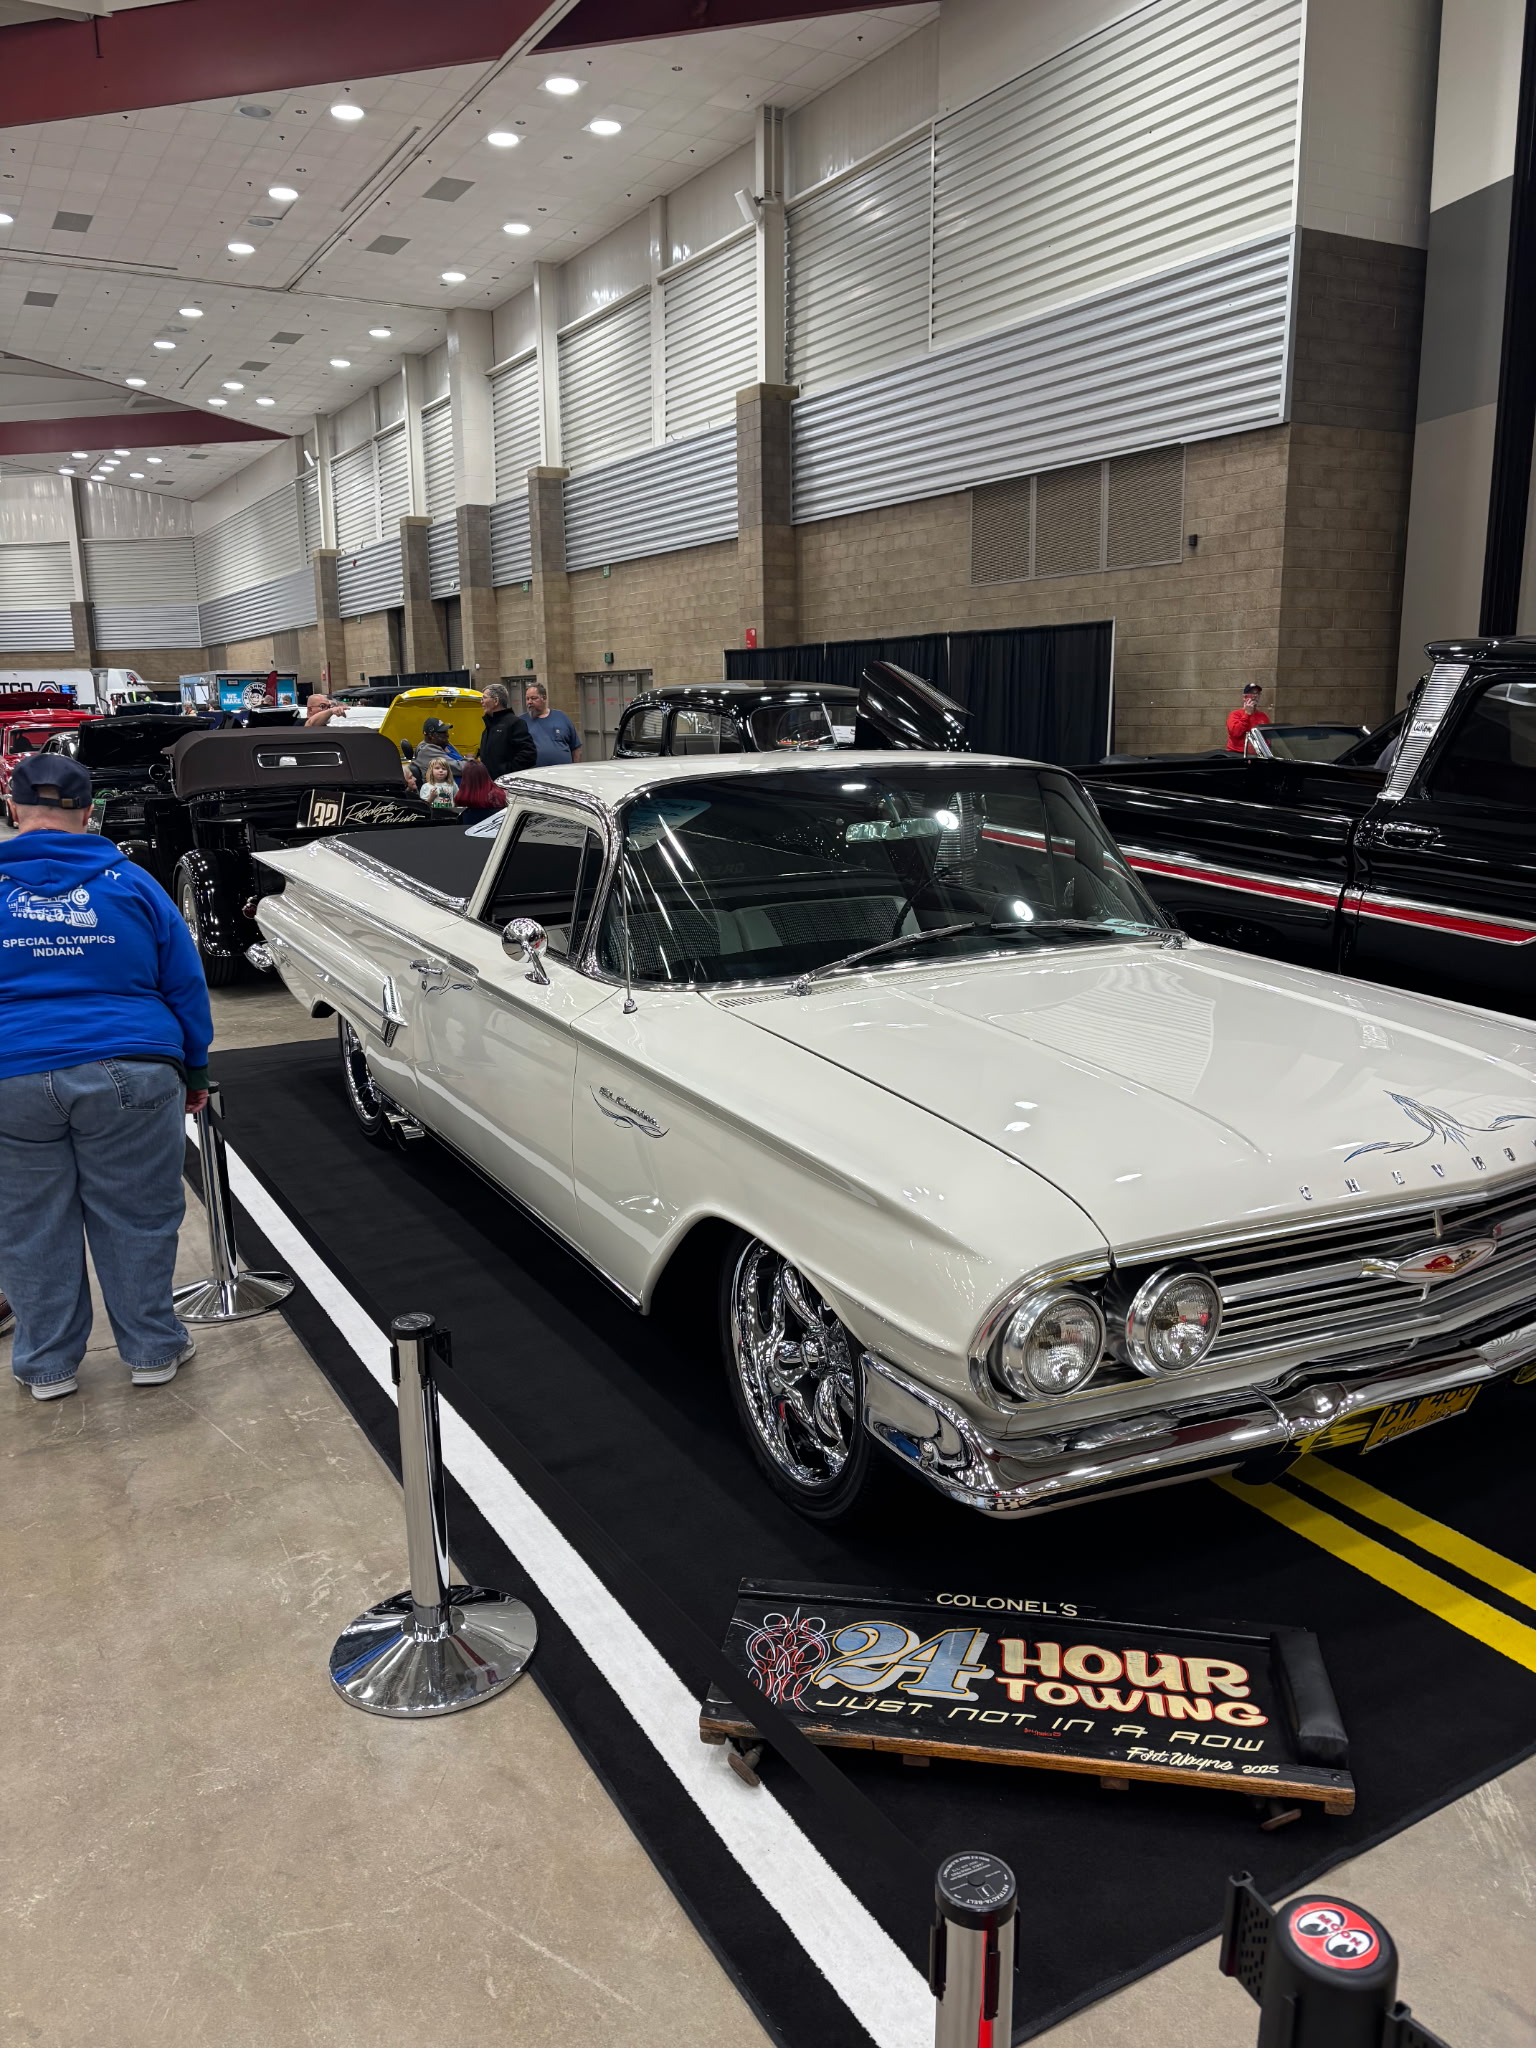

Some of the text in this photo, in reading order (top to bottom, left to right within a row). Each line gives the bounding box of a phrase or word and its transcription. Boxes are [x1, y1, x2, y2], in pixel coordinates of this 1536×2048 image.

[0, 682, 33, 693] TCO
[2, 935, 116, 948] SPECIAL OLYMPICS
[32, 946, 85, 958] INDIANA
[1299, 1138, 1536, 1201] CHEVRO
[1387, 1419, 1416, 1437] OHIO
[936, 1593, 1078, 1617] COLONEL'S
[811, 1620, 1251, 1701] 24 HOUR
[995, 1677, 1269, 1727] TOWING
[815, 1696, 933, 1716] JUST
[947, 1706, 1038, 1726] NOT
[1051, 1717, 1097, 1734] IN
[1111, 1724, 1149, 1740] A
[1168, 1730, 1265, 1752] ROW
[1126, 1746, 1280, 1775] Fort Wayne 2025
[1317, 1913, 1363, 1947] MOON
